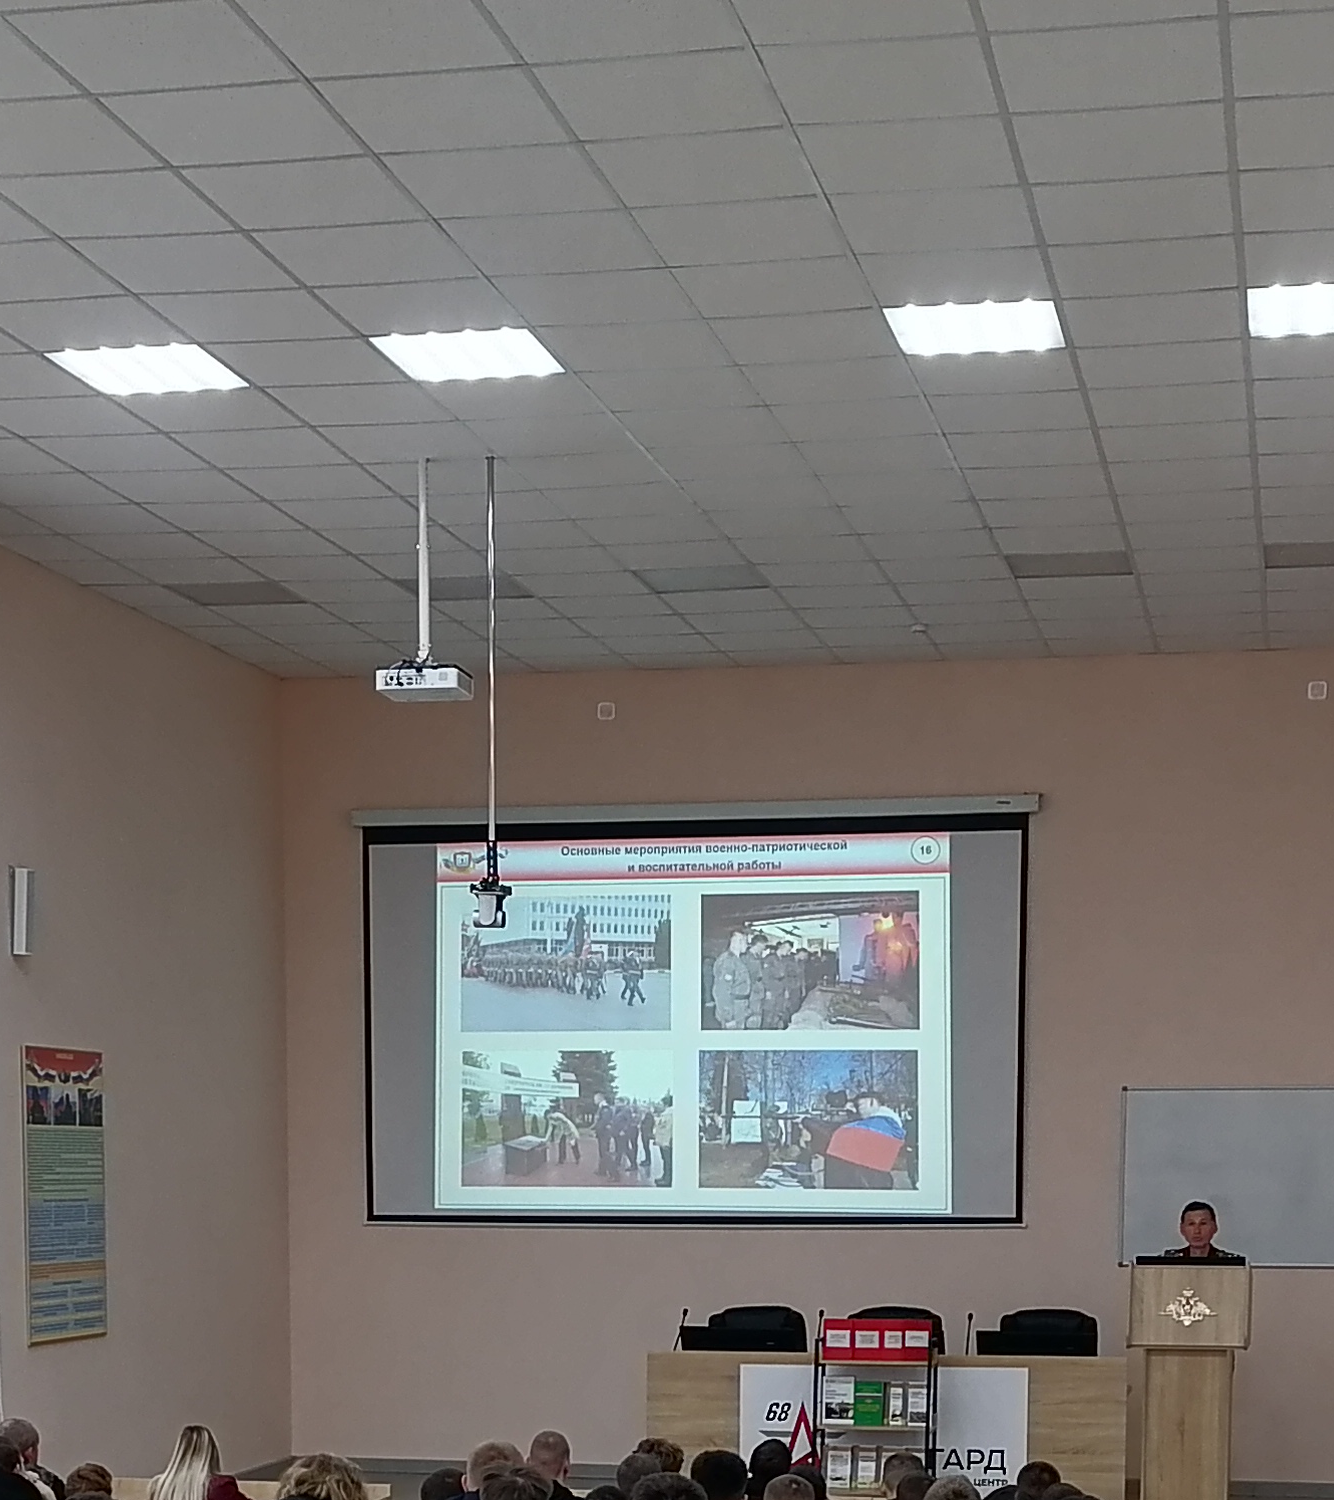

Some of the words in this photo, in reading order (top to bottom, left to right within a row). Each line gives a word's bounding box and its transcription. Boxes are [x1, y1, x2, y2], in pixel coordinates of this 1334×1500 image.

[561, 845, 621, 856] Основные
[624, 843, 702, 857] мероприятия
[705, 839, 848, 855] военно-патриотической
[919, 845, 933, 856] 16
[627, 863, 635, 872] и
[638, 860, 734, 872] воспитательной
[737, 860, 782, 873] работы
[765, 1402, 792, 1422] 68
[973, 1478, 1009, 1488] ЦЕНТР
